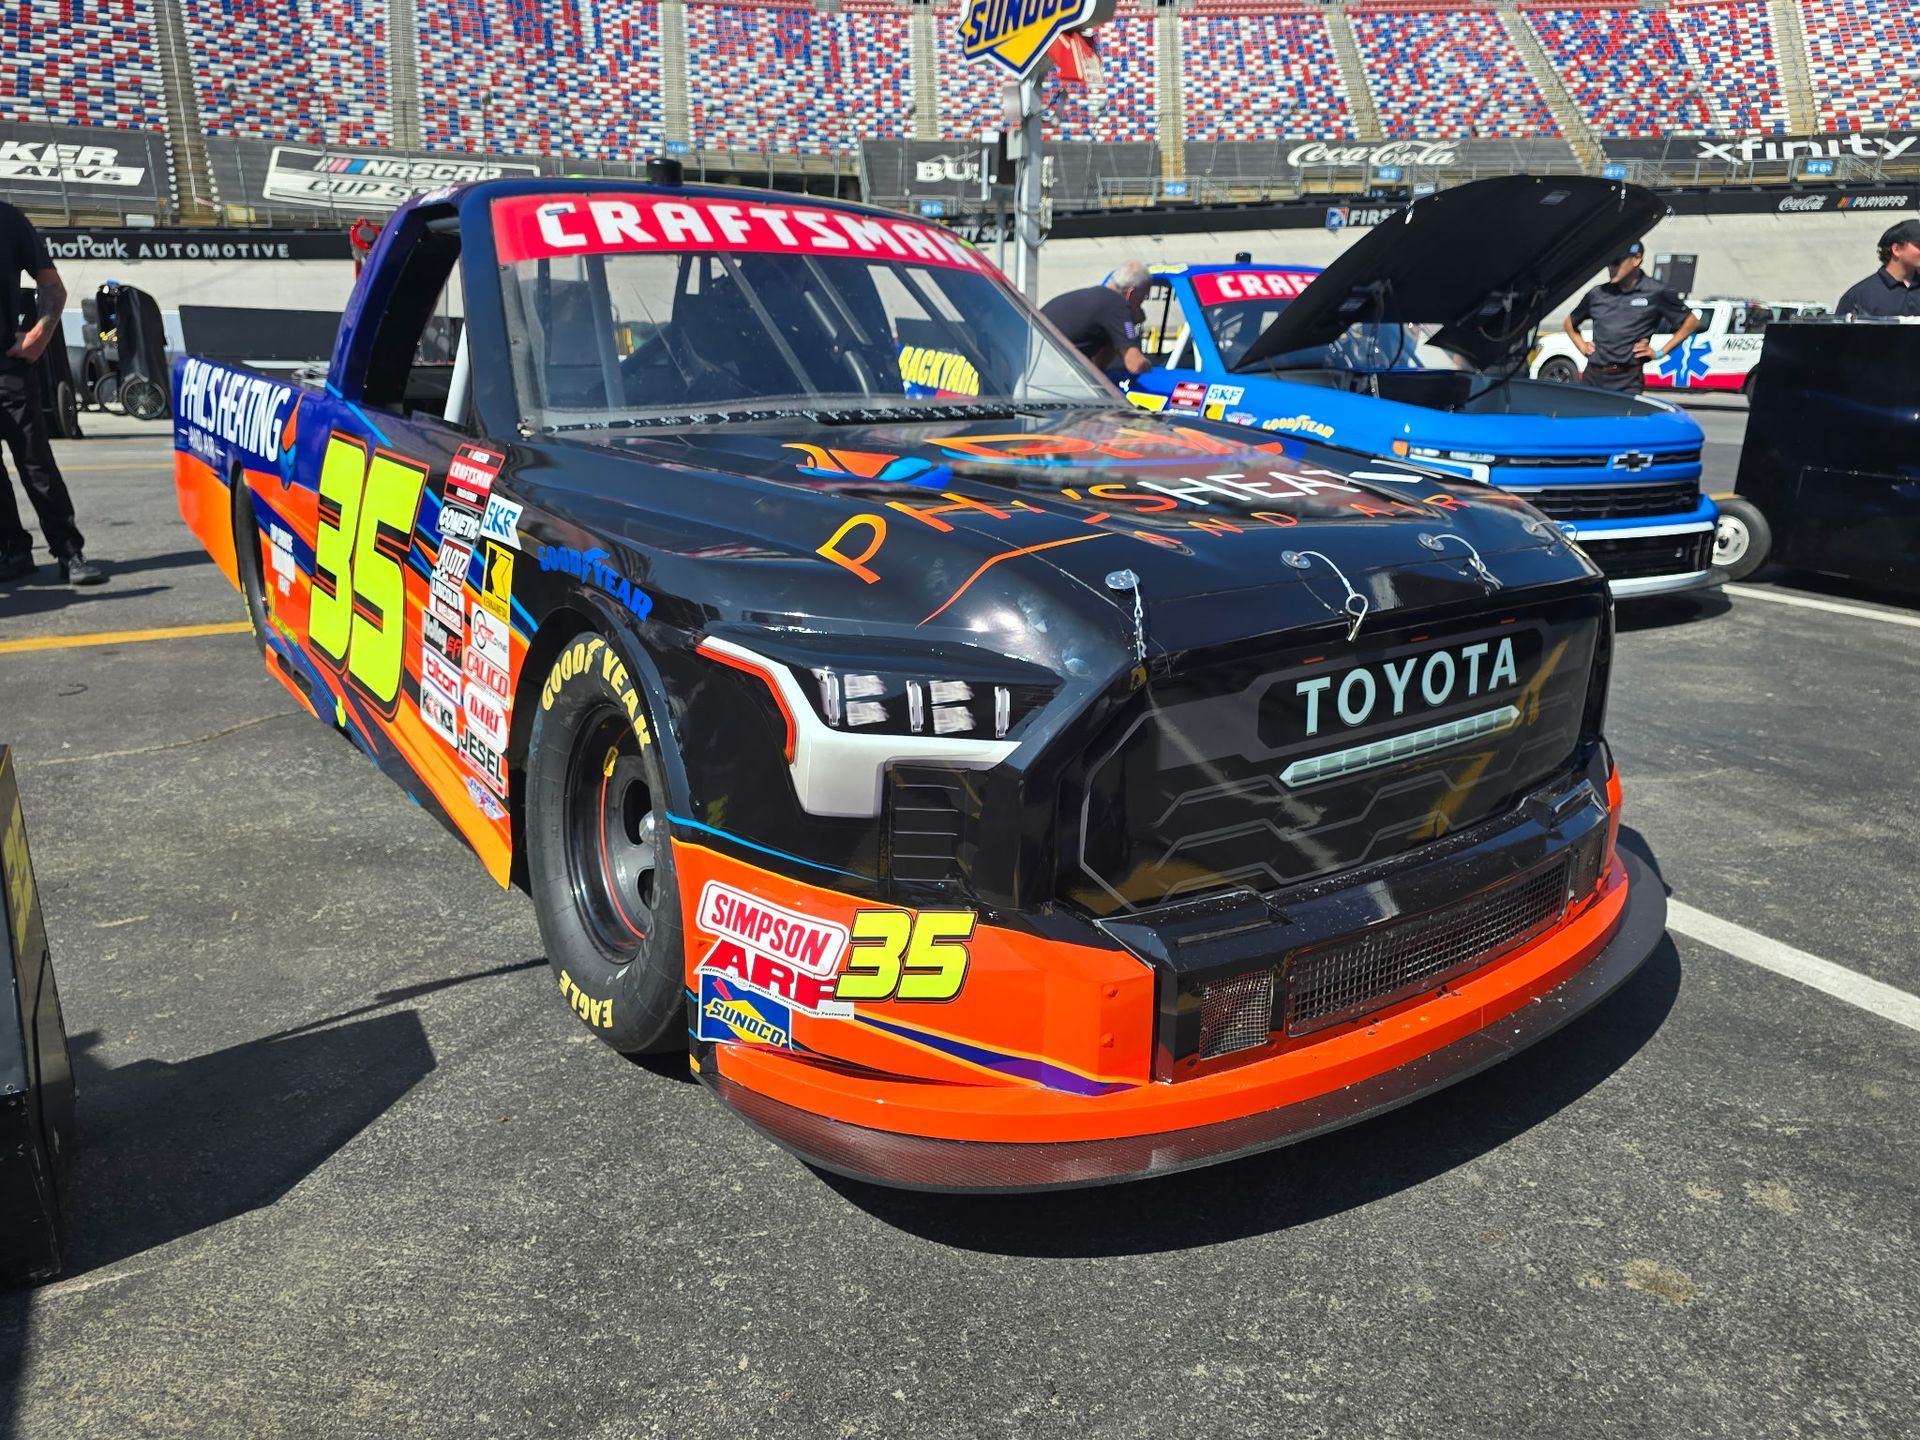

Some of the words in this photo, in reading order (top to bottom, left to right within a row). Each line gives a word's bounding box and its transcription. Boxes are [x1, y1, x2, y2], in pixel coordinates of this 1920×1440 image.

[1697, 133, 1919, 165] xfinity
[1853, 195, 1909, 208] PLAYOFFS
[139, 242, 290, 259] AUTOMOTIVE
[216, 370, 293, 463] HEATING
[1261, 414, 1336, 440] GOODYEAR
[483, 500, 518, 539] SKF
[308, 432, 429, 714] 35
[537, 545, 654, 622] GOODYEAR
[467, 651, 508, 698] CALICO
[541, 638, 652, 751] GOODYEAR
[1296, 636, 1519, 736] TOYOTA
[460, 728, 504, 786] JESEL
[712, 893, 832, 968] SIMPSON
[833, 909, 979, 1004] 35
[558, 969, 614, 1028] EAGLE
[709, 1000, 785, 1045] SUNOCO
